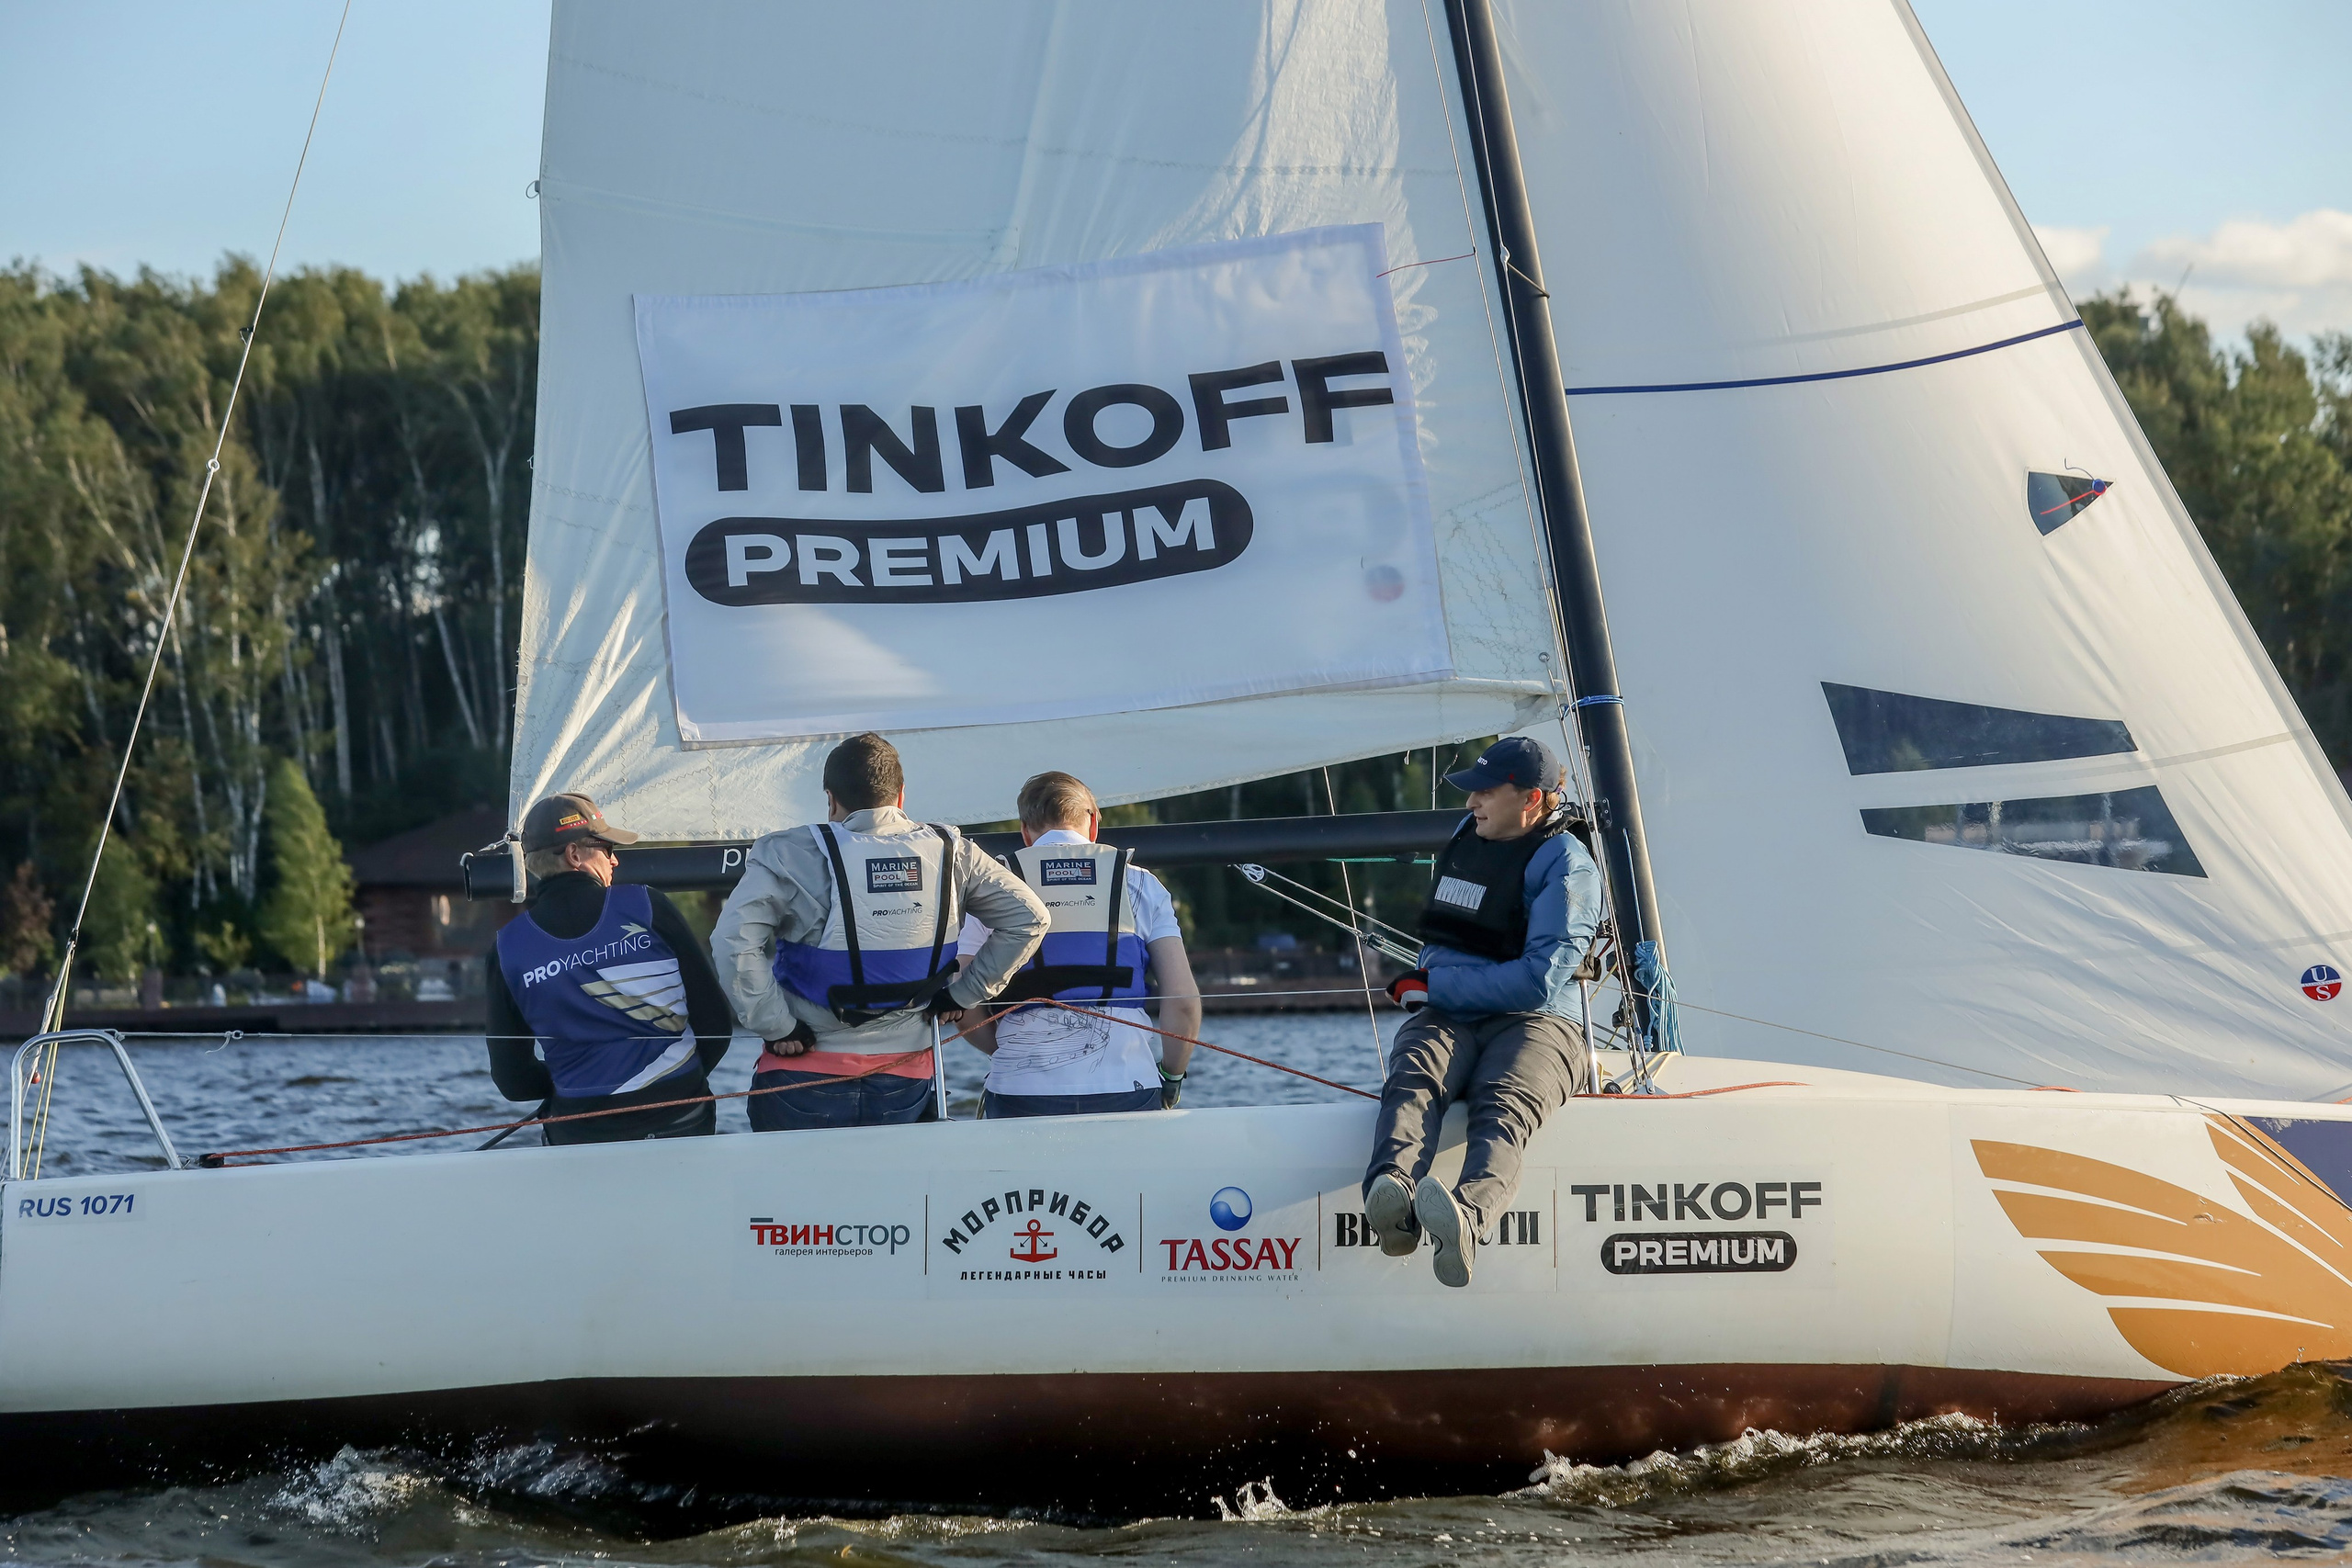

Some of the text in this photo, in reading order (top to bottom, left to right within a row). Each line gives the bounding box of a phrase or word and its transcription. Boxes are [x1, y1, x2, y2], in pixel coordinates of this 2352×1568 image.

[670, 351, 1395, 493] TINKOFF
[724, 497, 1216, 588] PREMIUM
[871, 862, 917, 872] MARINE
[872, 907, 922, 917] PROYACHTING
[523, 934, 651, 988] PROYACHTING
[18, 1194, 135, 1218] RUS 1071
[1570, 1181, 1822, 1222] TINKOFF
[942, 1189, 1125, 1255] МОРПРИБОР
[775, 1247, 874, 1258] галерея интерьеров
[1159, 1237, 1302, 1271] TASSAY
[1613, 1238, 1784, 1267] PREMIUM
[960, 1269, 1107, 1281] ЛЕГЕНДАРНЫЕ ЧАСЫ
